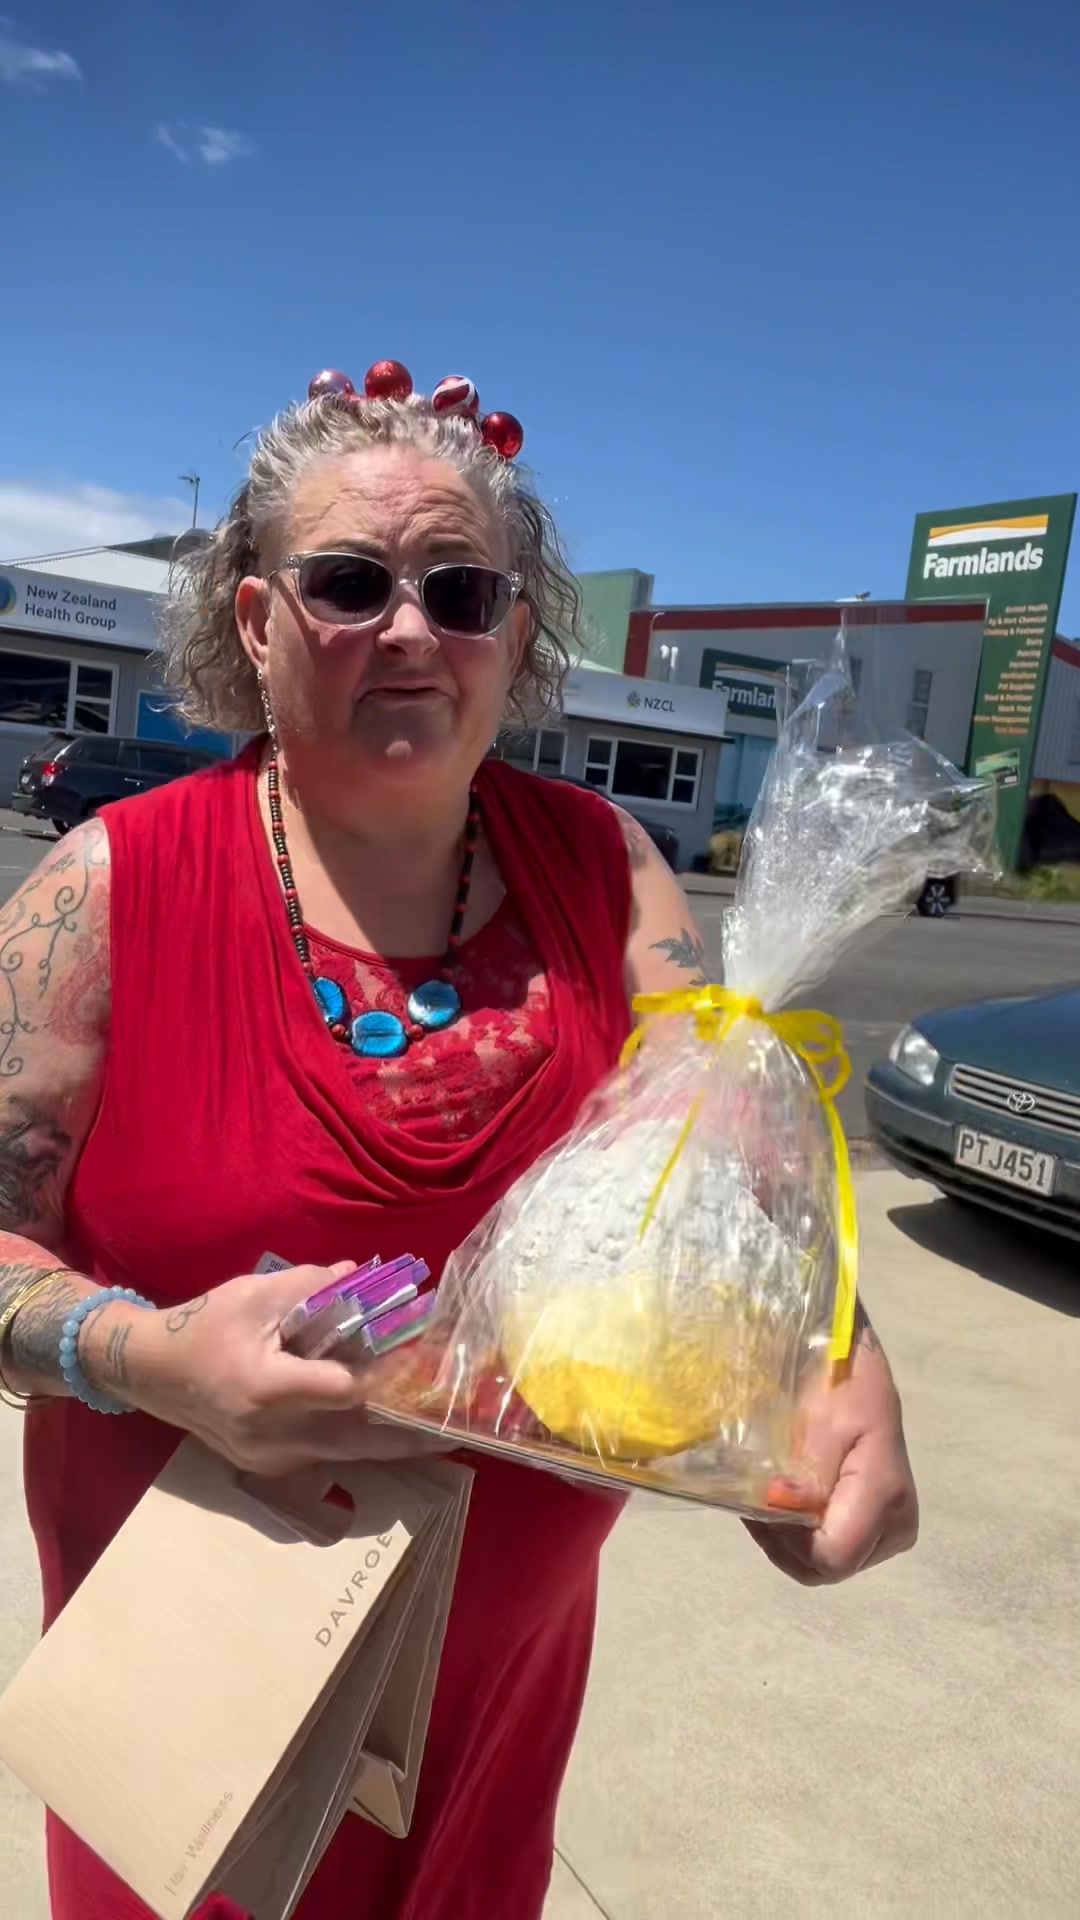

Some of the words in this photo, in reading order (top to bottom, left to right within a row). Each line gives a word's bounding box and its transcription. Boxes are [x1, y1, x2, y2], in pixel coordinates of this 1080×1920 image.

[923, 542, 1044, 579] Farmlands
[26, 584, 59, 600] New
[62, 589, 117, 611] Zealand
[25, 602, 71, 622] Health
[75, 611, 117, 631] Group
[643, 697, 676, 712] NZCL
[712, 680, 777, 709] Farmlan
[960, 1133, 1047, 1187] PTJ451
[314, 1534, 393, 1648] DAVROE
[184, 1791, 234, 1859] Wellness
